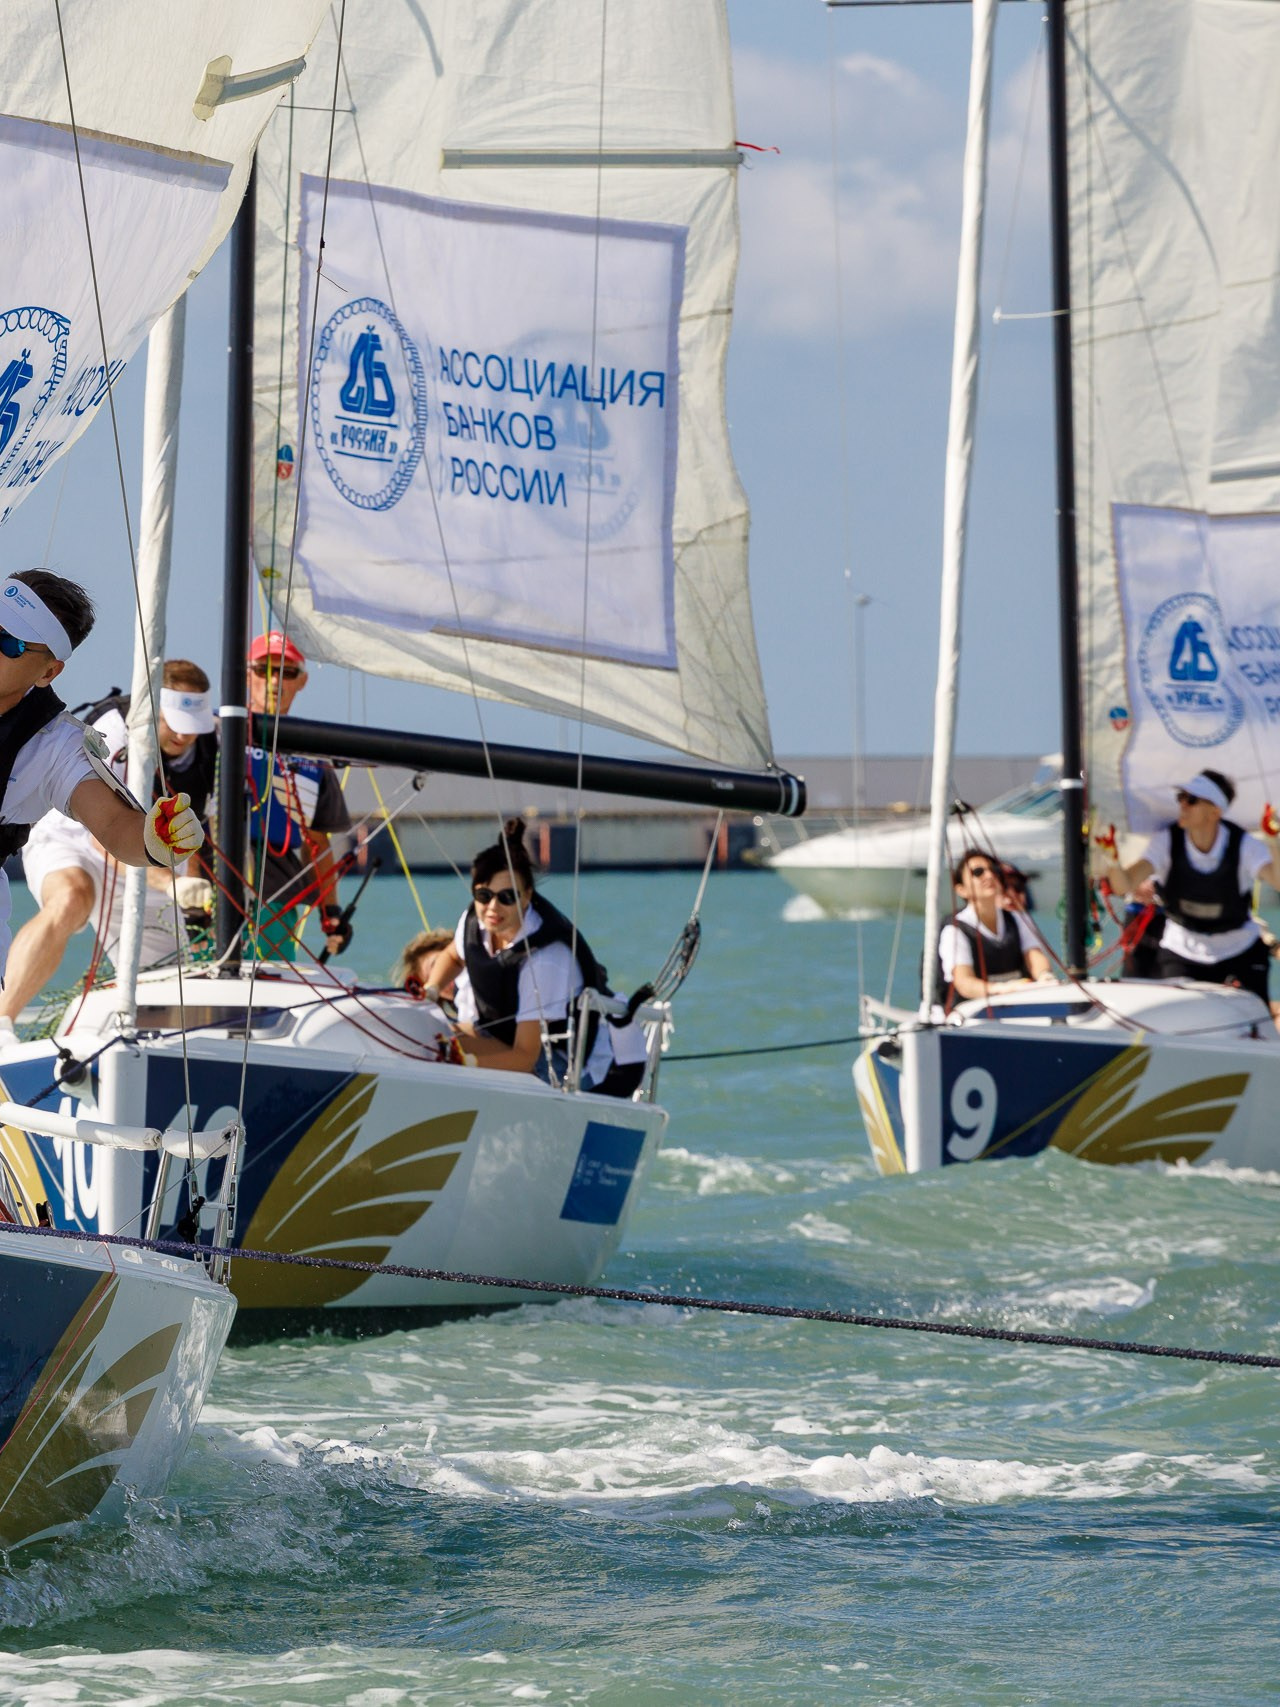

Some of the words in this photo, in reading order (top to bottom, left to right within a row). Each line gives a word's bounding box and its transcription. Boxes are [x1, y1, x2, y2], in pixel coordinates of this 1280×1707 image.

[439, 346, 666, 410] АССОЦИАЦИЯ
[443, 401, 557, 451] БАНКОВ
[451, 456, 568, 507] РОССИИ
[947, 1066, 998, 1161] 9
